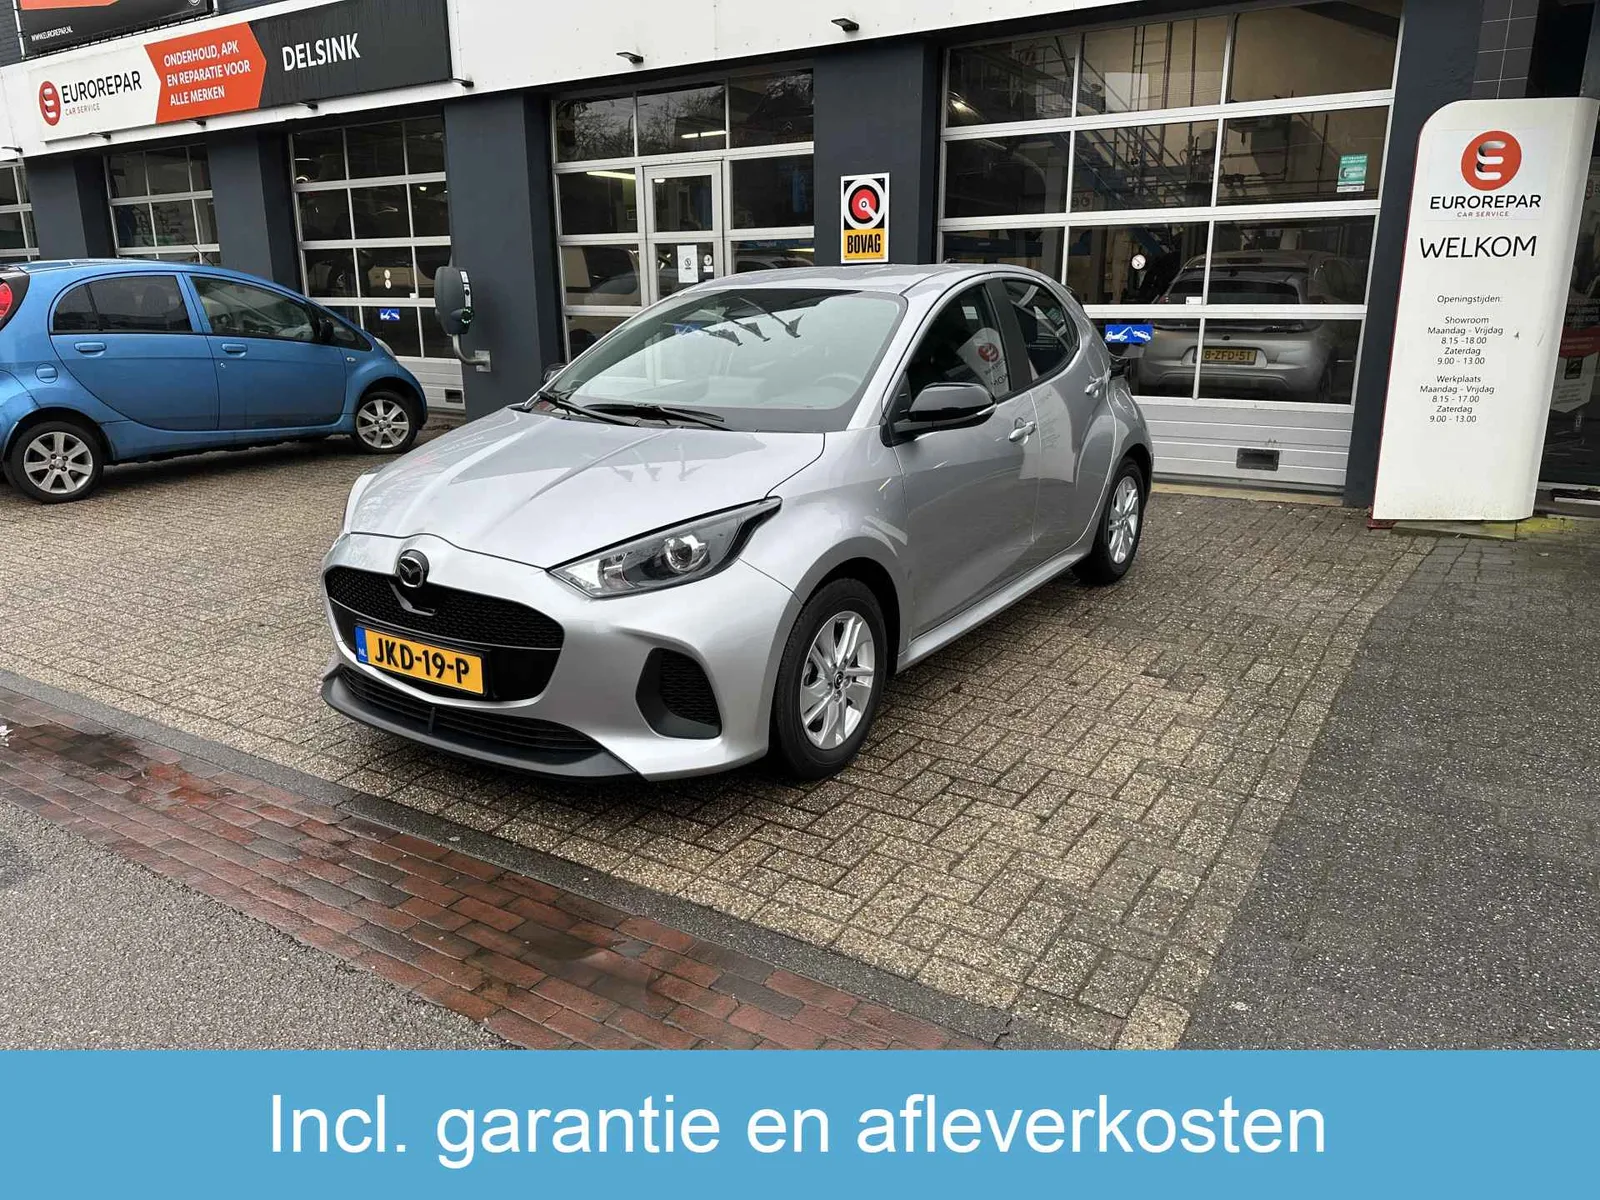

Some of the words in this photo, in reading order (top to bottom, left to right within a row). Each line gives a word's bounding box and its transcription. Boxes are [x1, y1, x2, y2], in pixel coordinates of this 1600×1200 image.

[163, 44, 220, 67] ONDERHOUD,
[221, 39, 239, 56] APK
[281, 32, 361, 72] DELSINK
[166, 74, 178, 88] EN
[178, 64, 223, 84] REPARATIE
[223, 59, 251, 77] VOOR
[61, 70, 142, 104] EUROREPAR
[170, 92, 189, 106] ALLE
[190, 85, 225, 103] MERKEN
[65, 107, 76, 116] CAR
[77, 102, 100, 114] SERVICE
[1429, 194, 1542, 210] EUROREPAR
[1475, 210, 1510, 218] SERVICE
[847, 233, 881, 254] BOVAG
[1419, 235, 1537, 259] WELKOM
[1444, 316, 1490, 324] Showroom
[1427, 326, 1466, 336] Maandag
[1474, 326, 1504, 336] Vrijdag
[1444, 347, 1481, 356] Zaterdag
[1437, 357, 1455, 365] 9.00
[1464, 357, 1485, 365] 13.00
[1436, 375, 1482, 384] Werkplaats
[1419, 385, 1458, 395] Maandag
[1466, 384, 1495, 395] Vrijdag
[1432, 395, 1449, 403] 8.15
[1458, 395, 1480, 403] 17.00
[1436, 405, 1473, 414] Zaterdag
[1429, 415, 1447, 423] 9.00
[1455, 415, 1477, 423] 13.00
[358, 648, 367, 656] NL
[375, 638, 470, 683] JKD-19-P
